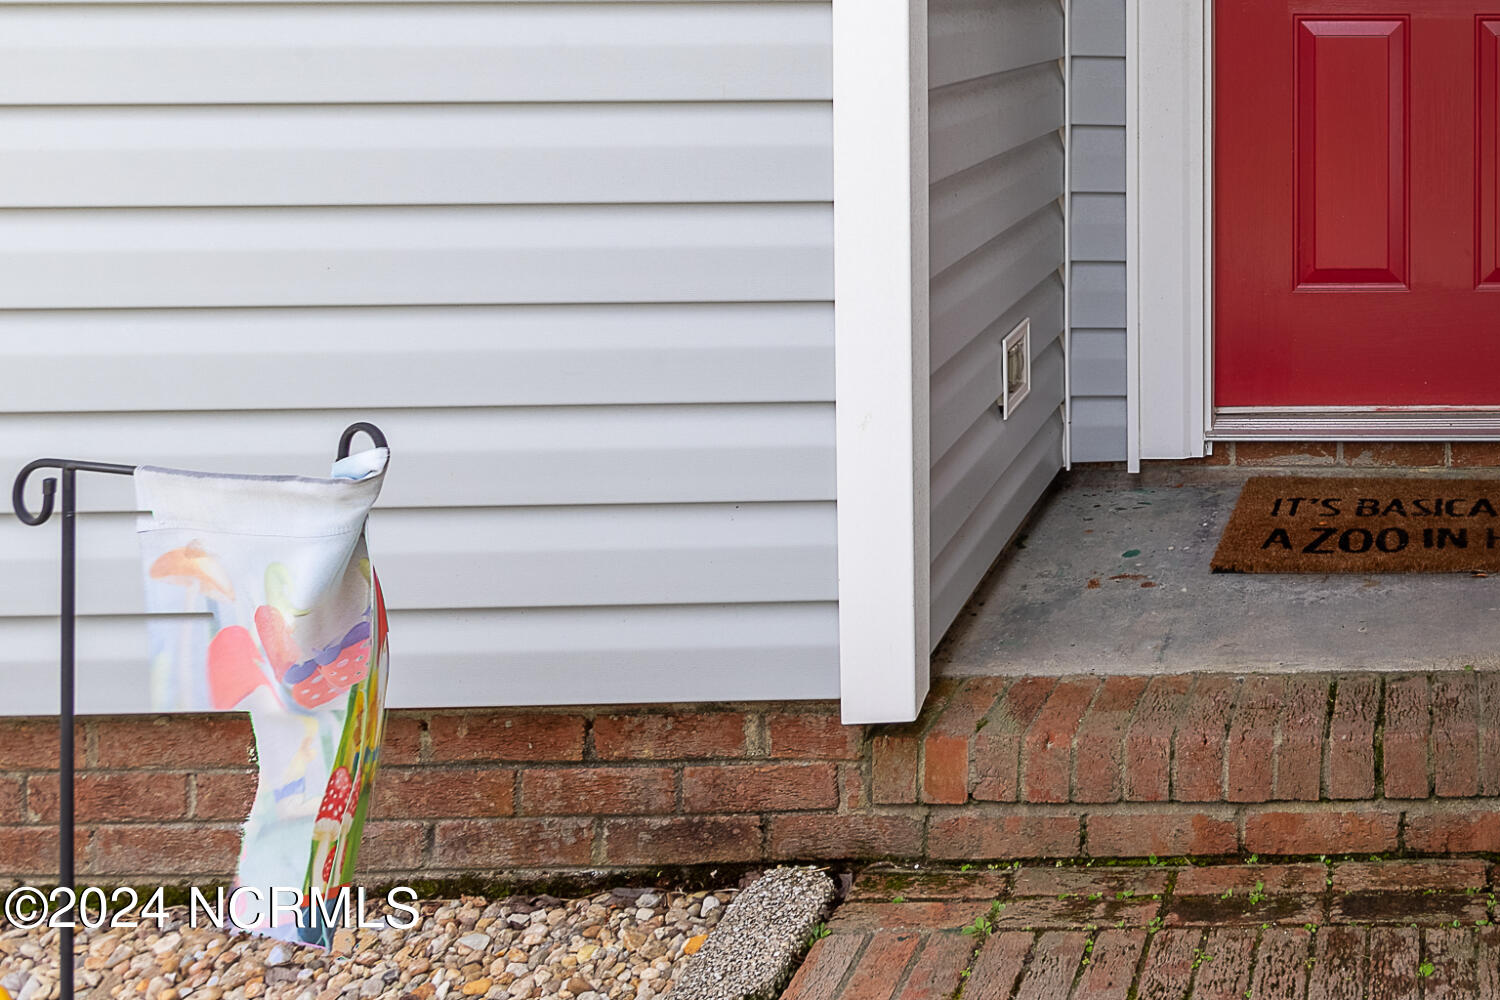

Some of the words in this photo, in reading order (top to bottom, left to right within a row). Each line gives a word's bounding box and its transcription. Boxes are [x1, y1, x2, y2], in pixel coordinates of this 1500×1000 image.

[1270, 497, 1342, 517] IT'S
[1261, 528, 1293, 550] A
[1301, 527, 1410, 553] ZOO
[1423, 528, 1467, 549] IN
